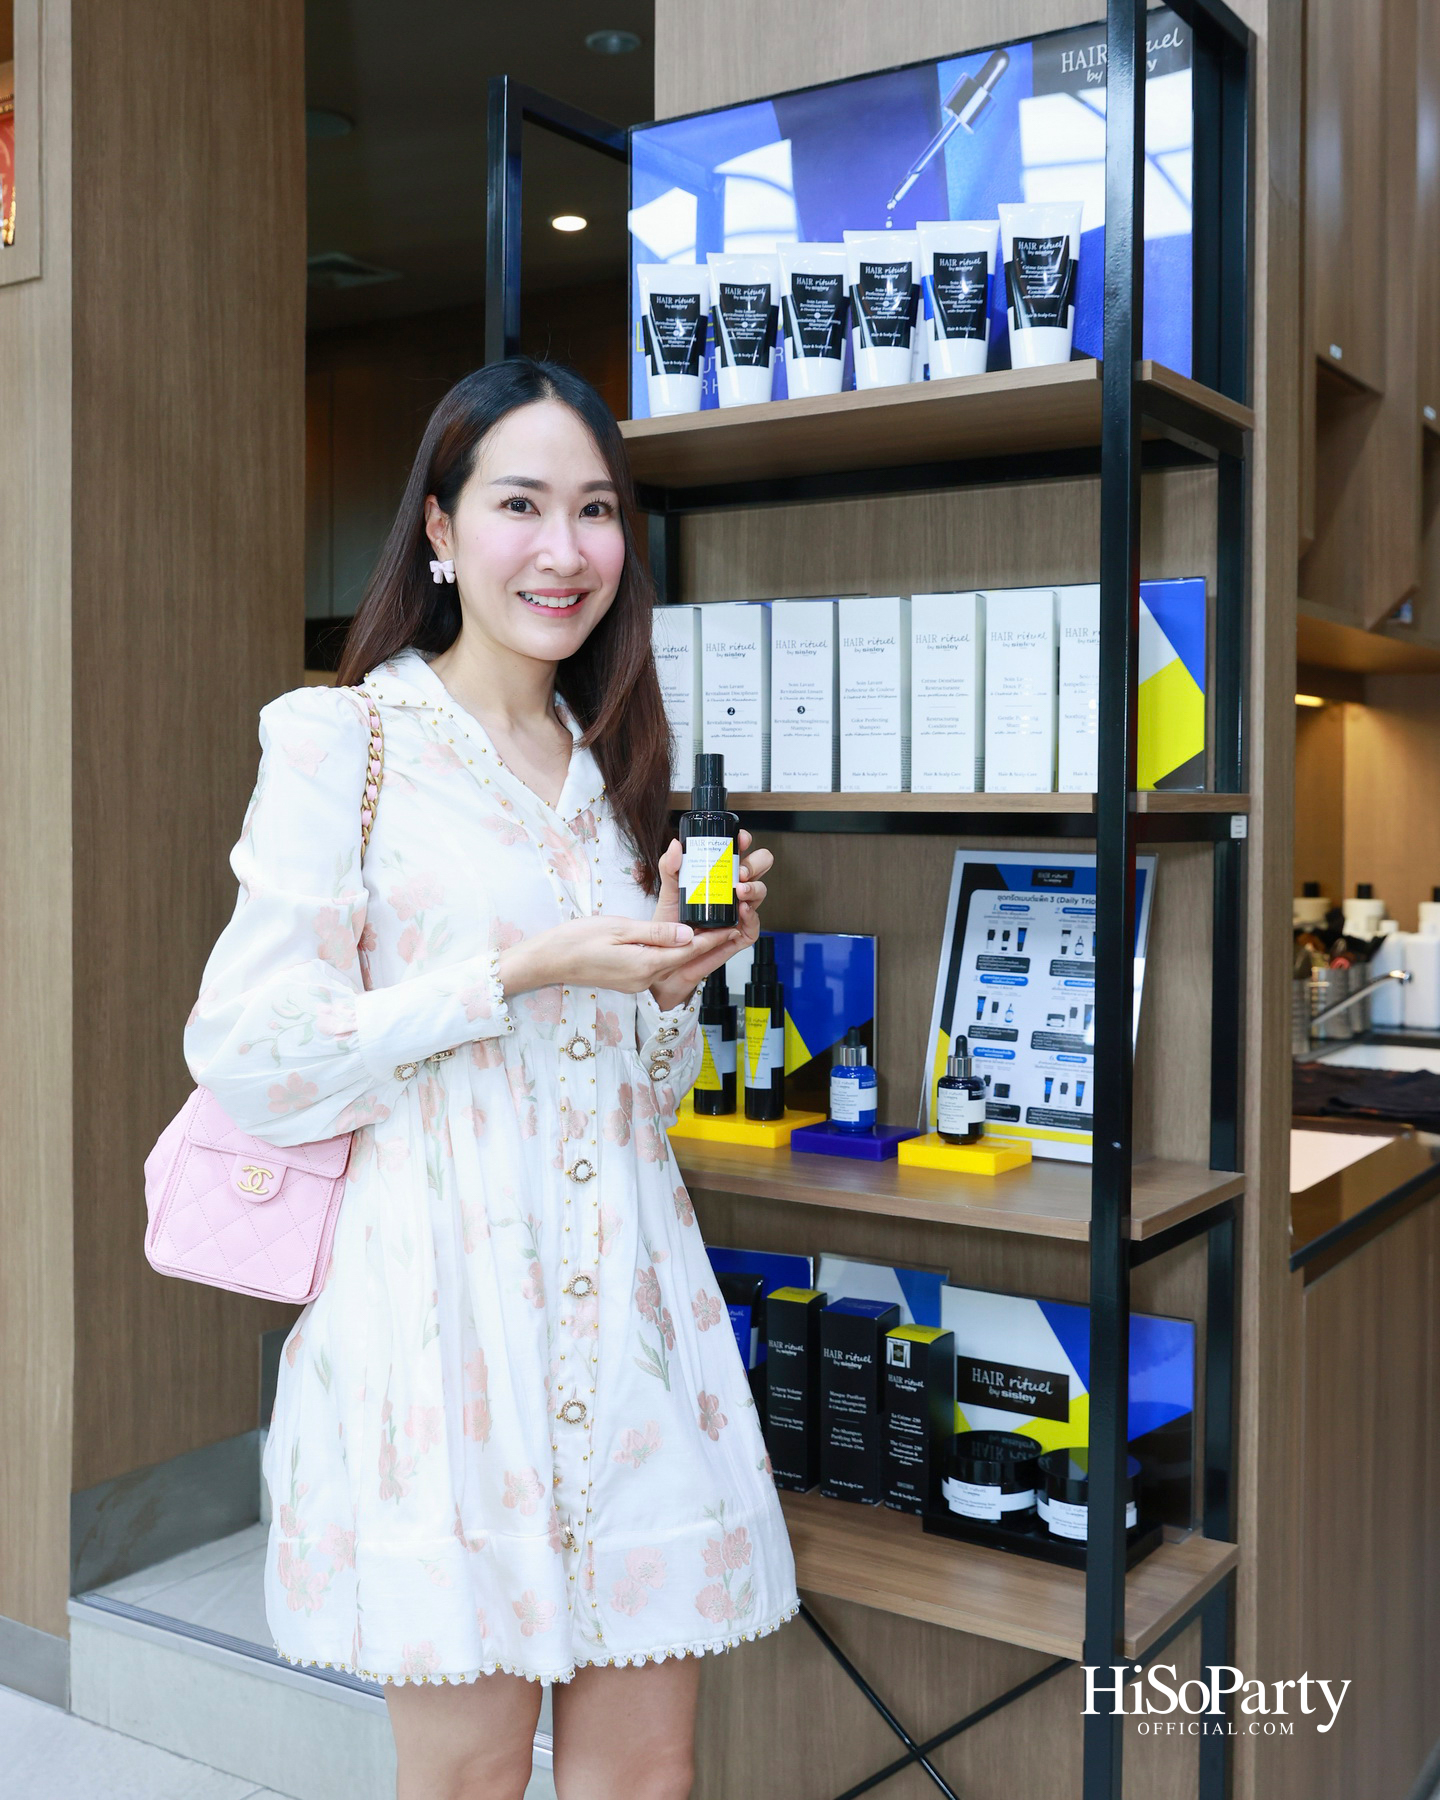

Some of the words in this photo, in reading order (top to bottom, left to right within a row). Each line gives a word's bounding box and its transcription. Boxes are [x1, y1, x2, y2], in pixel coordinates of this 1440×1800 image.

[1061, 43, 1107, 73] HAIR
[1086, 69, 1103, 83] by
[1018, 241, 1037, 250] HAIR
[1039, 240, 1063, 249] rituel
[939, 258, 958, 267] HAIR
[959, 257, 982, 266] rituel
[865, 266, 883, 274] HAIR
[884, 265, 908, 274] rituel
[796, 277, 814, 286] HAIR
[815, 278, 838, 286] rituel
[724, 287, 742, 295] HAIR
[743, 287, 766, 296] rituel
[656, 296, 673, 304] HAIR
[674, 296, 696, 304] rituel
[990, 631, 1013, 641] HAIR
[1016, 631, 1048, 641] rituel
[1065, 627, 1089, 638] HAIR
[843, 637, 865, 647] HAIR
[867, 636, 896, 646] rituel
[916, 634, 938, 644] HAIR
[940, 633, 971, 643] rituel
[662, 644, 689, 653] rituel
[706, 642, 727, 652] HAIR
[729, 642, 758, 651] rituel
[776, 639, 797, 649] HAIR
[799, 639, 829, 649] rituel
[935, 643, 959, 651] sisley
[724, 651, 747, 659] sisley
[862, 646, 885, 654] sisley
[689, 839, 706, 847] HAIR
[708, 839, 729, 847] rituel
[1056, 897, 1079, 906] (Daily
[768, 1339, 784, 1349] HAIR
[784, 1343, 804, 1352] rituel
[823, 1347, 844, 1359] HAIR
[844, 1352, 873, 1364] rituel
[833, 1358, 840, 1367] by
[840, 1360, 863, 1370] sisley
[887, 1373, 904, 1385] HAIR
[904, 1377, 925, 1389] rituel
[972, 1367, 1005, 1387] HAIR
[1009, 1376, 1054, 1395] rituel
[988, 1385, 1001, 1398] by
[1001, 1389, 1037, 1405] sisley
